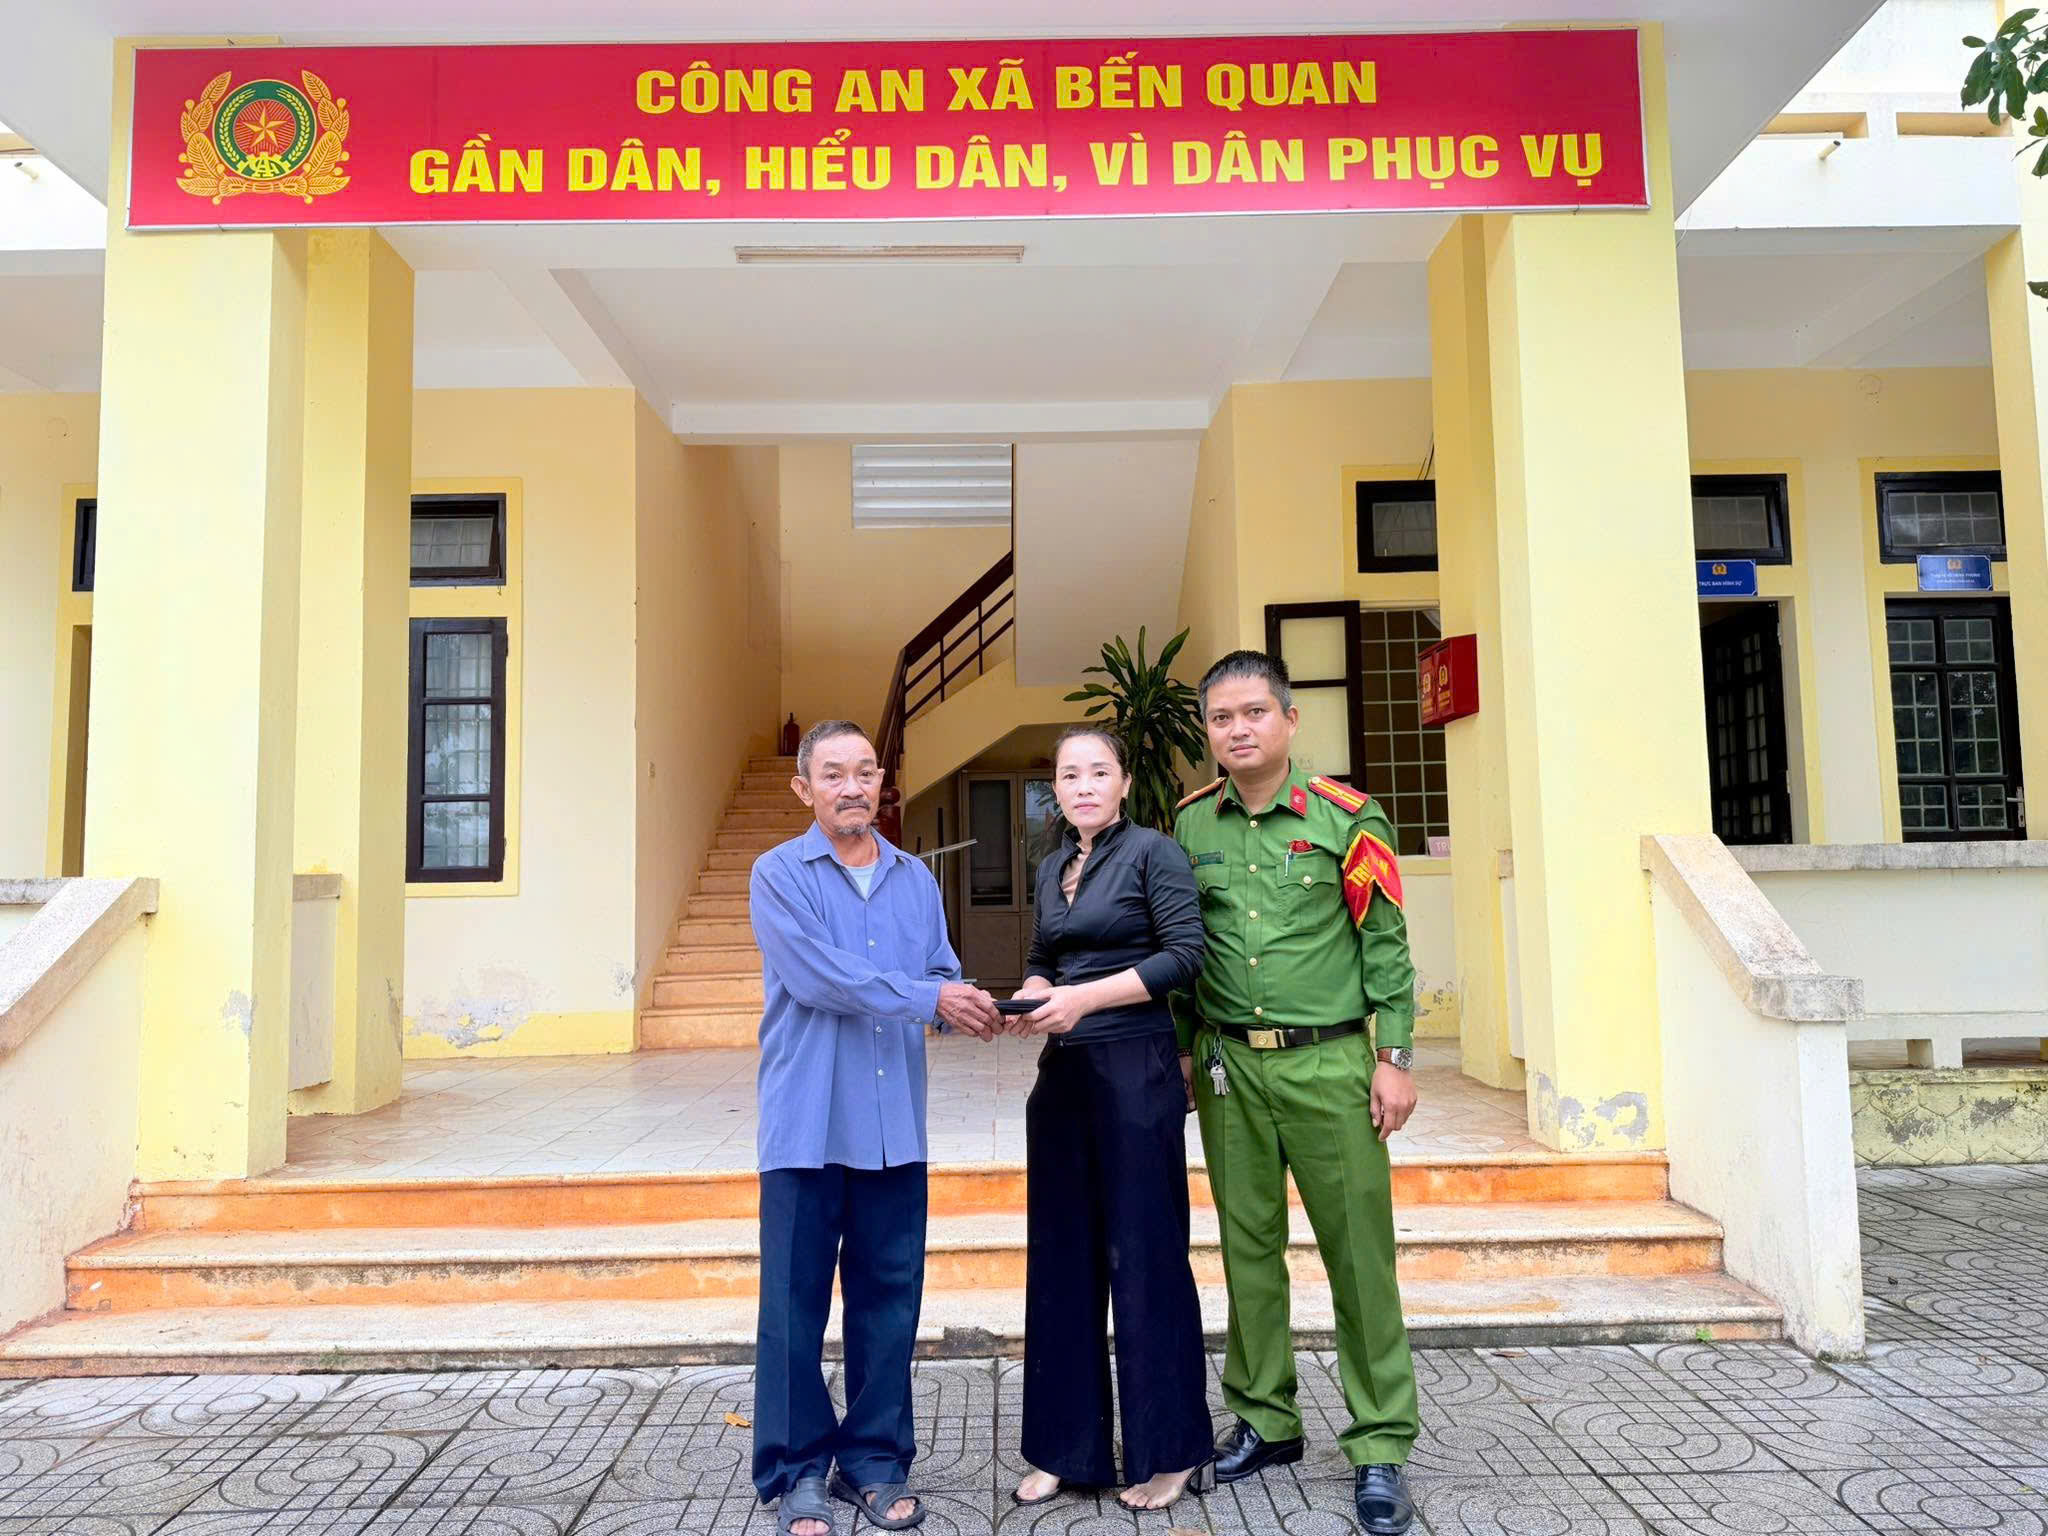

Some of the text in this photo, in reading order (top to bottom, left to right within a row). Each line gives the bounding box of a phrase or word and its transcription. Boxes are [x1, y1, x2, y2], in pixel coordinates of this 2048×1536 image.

[637, 51, 1377, 115] CÔNG AN XÃ BẾN QUAN
[409, 127, 1602, 198] GẦN DÂN, HIỂU DÂN, VÌ DÂN PHỤC VỤ
